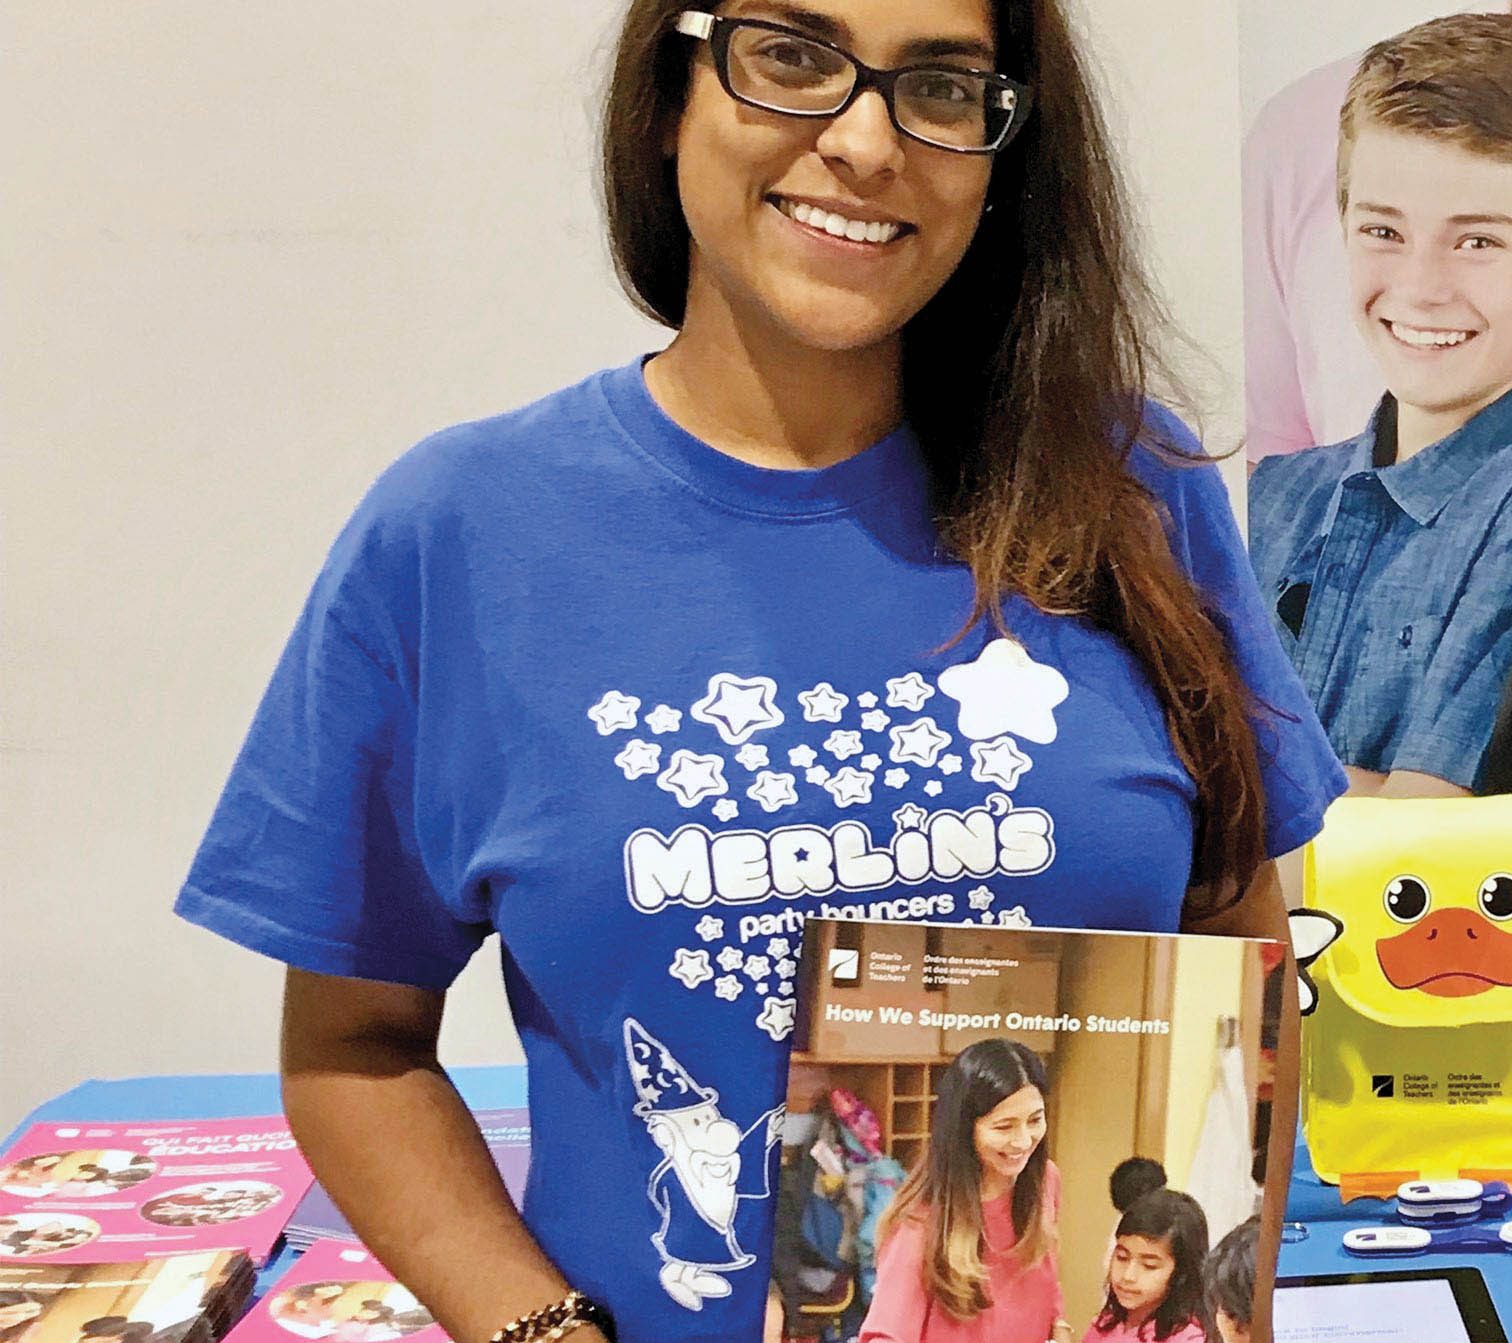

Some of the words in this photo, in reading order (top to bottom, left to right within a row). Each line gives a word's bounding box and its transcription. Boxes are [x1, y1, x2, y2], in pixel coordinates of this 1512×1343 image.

[738, 908, 816, 944] party
[821, 893, 955, 921] bouncers
[870, 951, 903, 961] Ontario
[923, 954, 947, 965] Ordre
[949, 956, 963, 965] des
[869, 961, 901, 972] College
[902, 963, 911, 972] of
[922, 965, 932, 974] et
[933, 965, 948, 974] des
[868, 972, 906, 982] Teachers
[921, 975, 933, 984] de
[825, 1003, 873, 1024] How
[878, 1006, 913, 1026] We
[917, 1009, 1001, 1032] Support
[1005, 1012, 1081, 1032] Ontario
[1085, 1014, 1170, 1035] Students
[185, 1134, 232, 1146] FAIT
